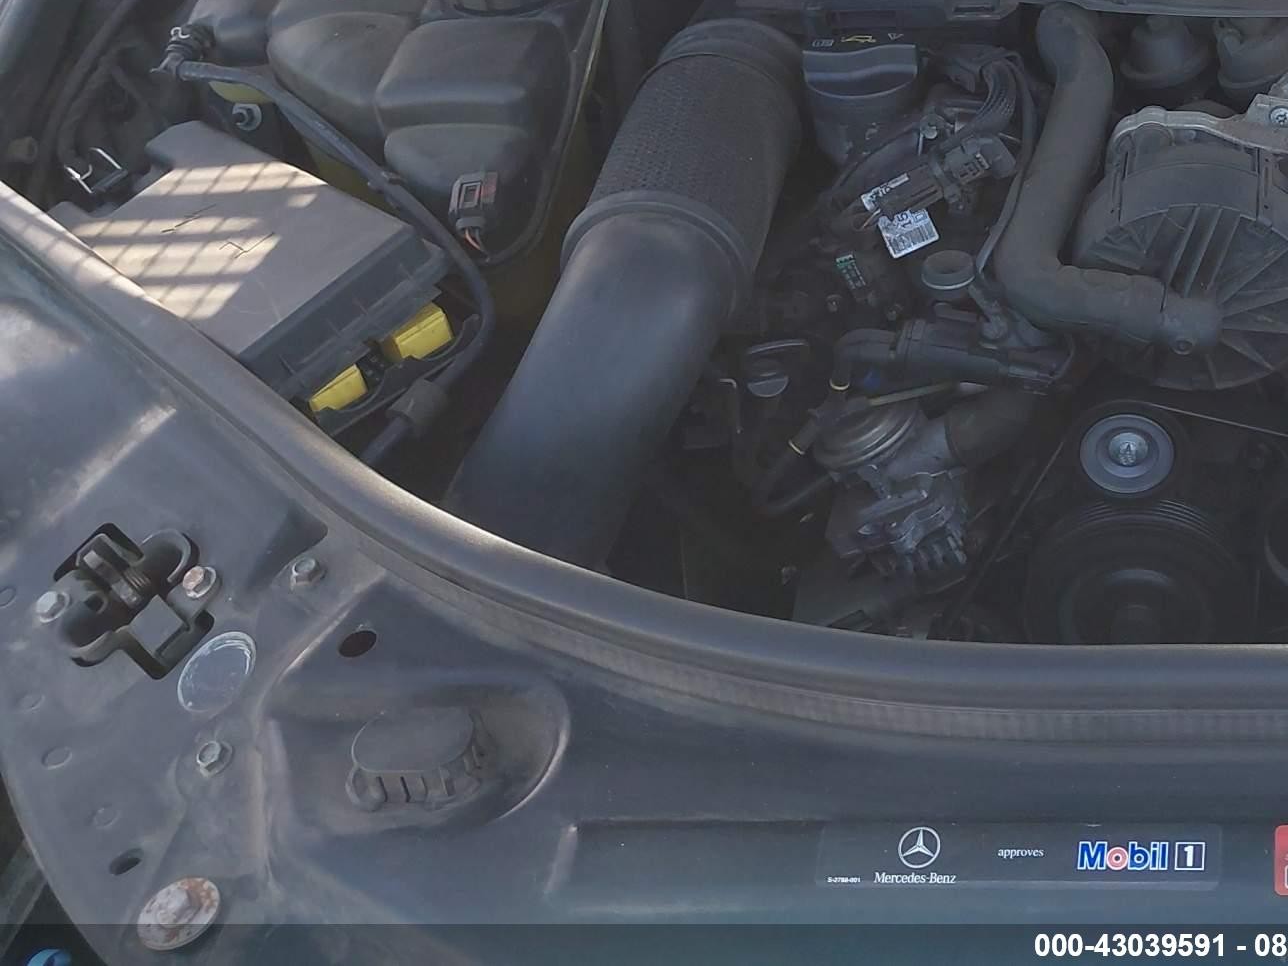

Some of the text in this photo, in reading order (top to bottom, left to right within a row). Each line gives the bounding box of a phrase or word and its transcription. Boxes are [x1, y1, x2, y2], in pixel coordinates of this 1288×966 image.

[997, 848, 1044, 859] approves
[1077, 841, 1168, 871] Mobil
[874, 872, 957, 884] Mercedes-Benz
